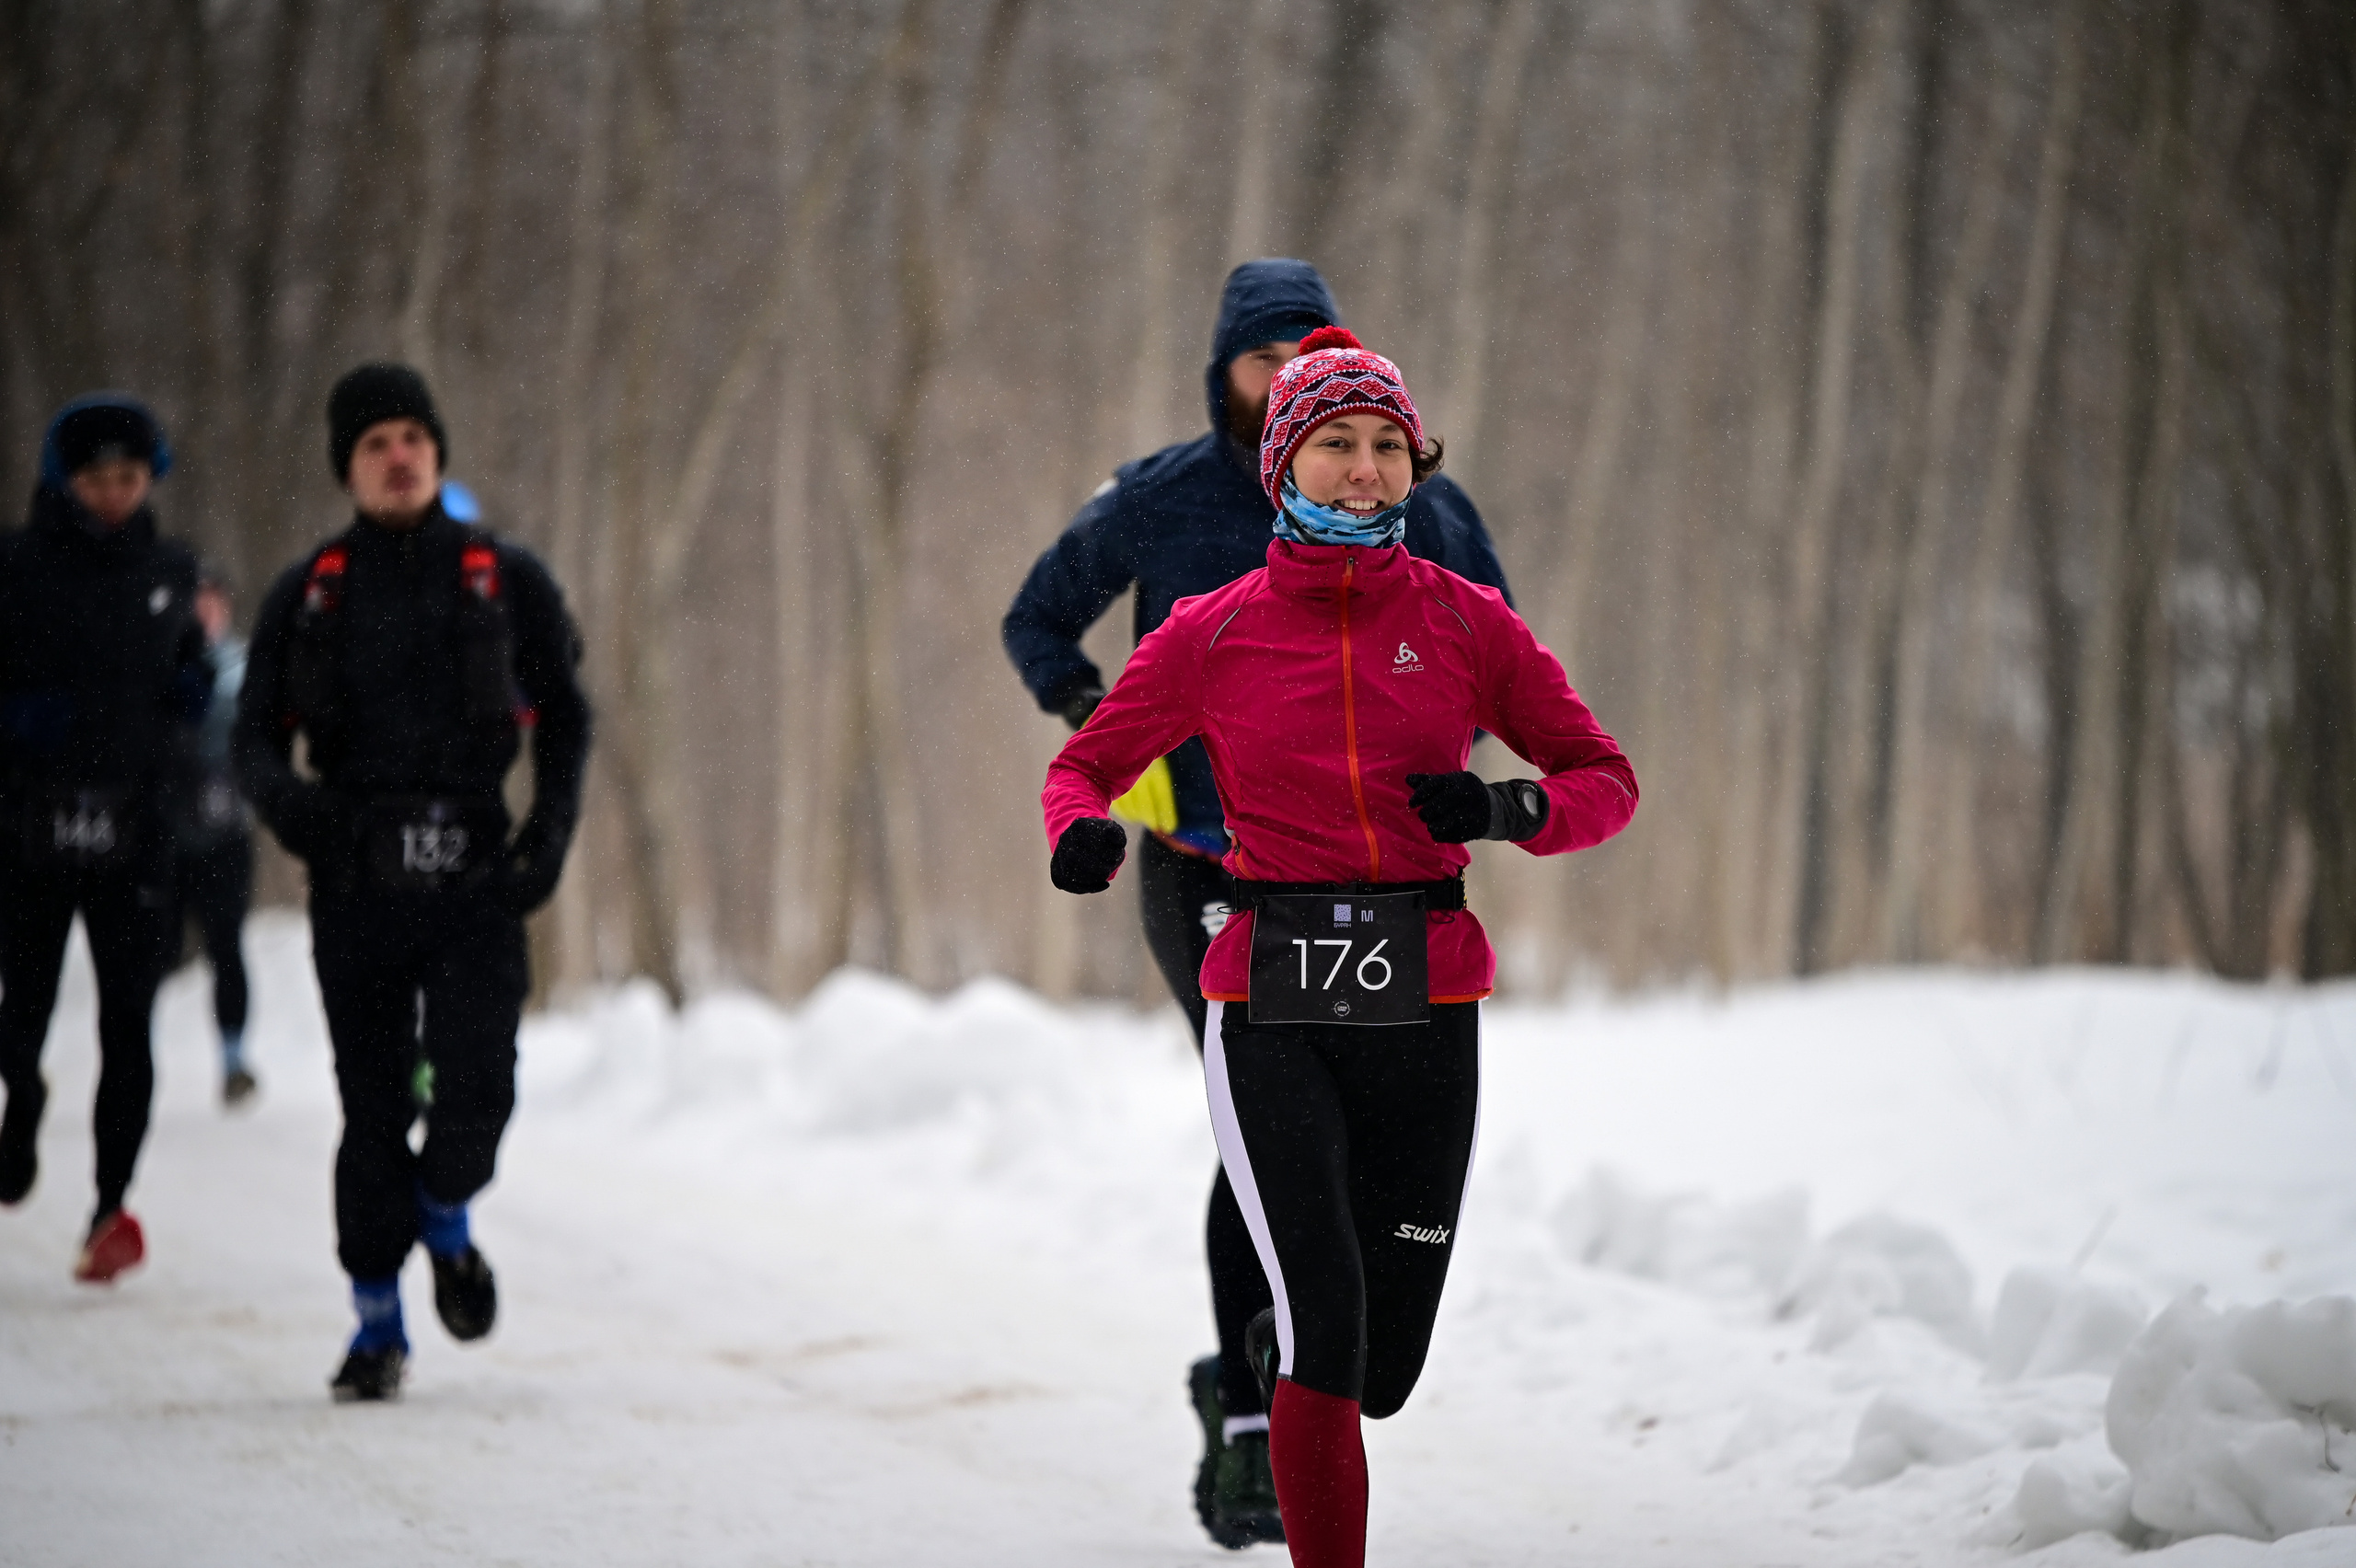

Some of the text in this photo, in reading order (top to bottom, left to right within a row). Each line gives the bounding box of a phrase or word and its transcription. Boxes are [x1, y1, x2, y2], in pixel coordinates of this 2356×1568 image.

[1392, 664, 1424, 674] odlo
[400, 824, 468, 872] 132
[1292, 939, 1392, 991] 176
